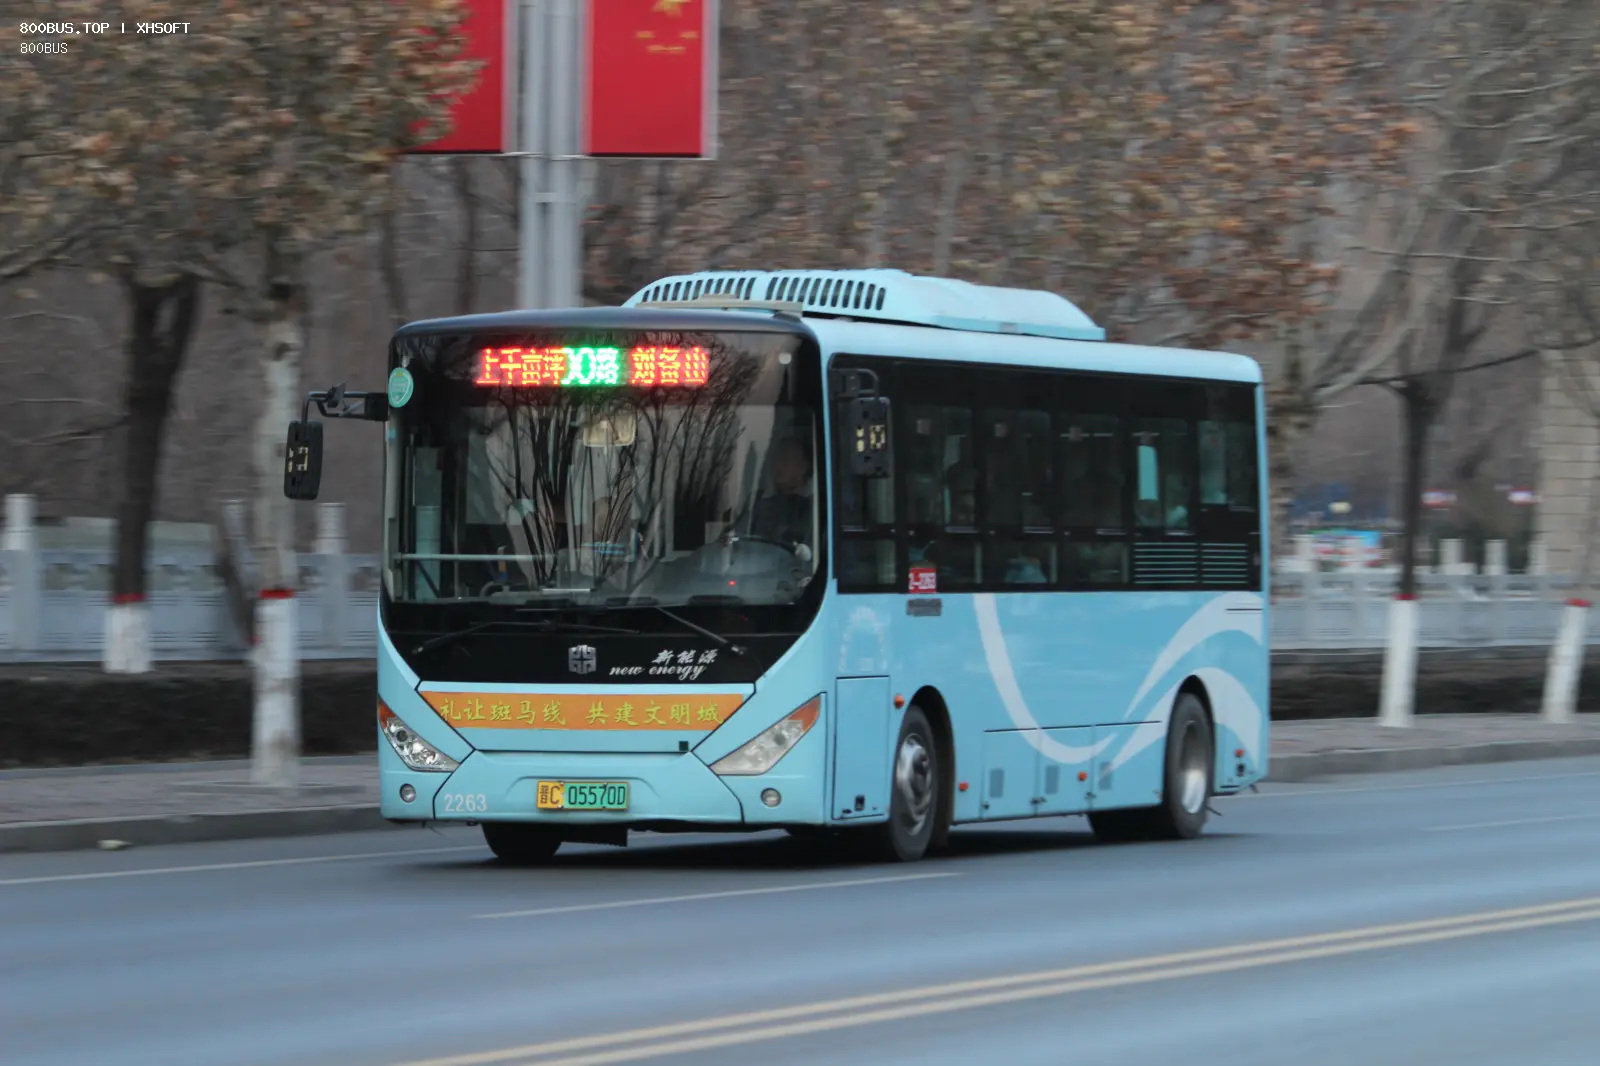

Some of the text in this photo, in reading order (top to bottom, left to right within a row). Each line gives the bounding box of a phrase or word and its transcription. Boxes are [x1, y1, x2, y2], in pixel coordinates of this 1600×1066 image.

[652, 649, 718, 664] 新能源
[609, 665, 707, 681] new energy
[440, 698, 724, 726] 礼让斑马线 共建文明城
[444, 793, 488, 812] 2263
